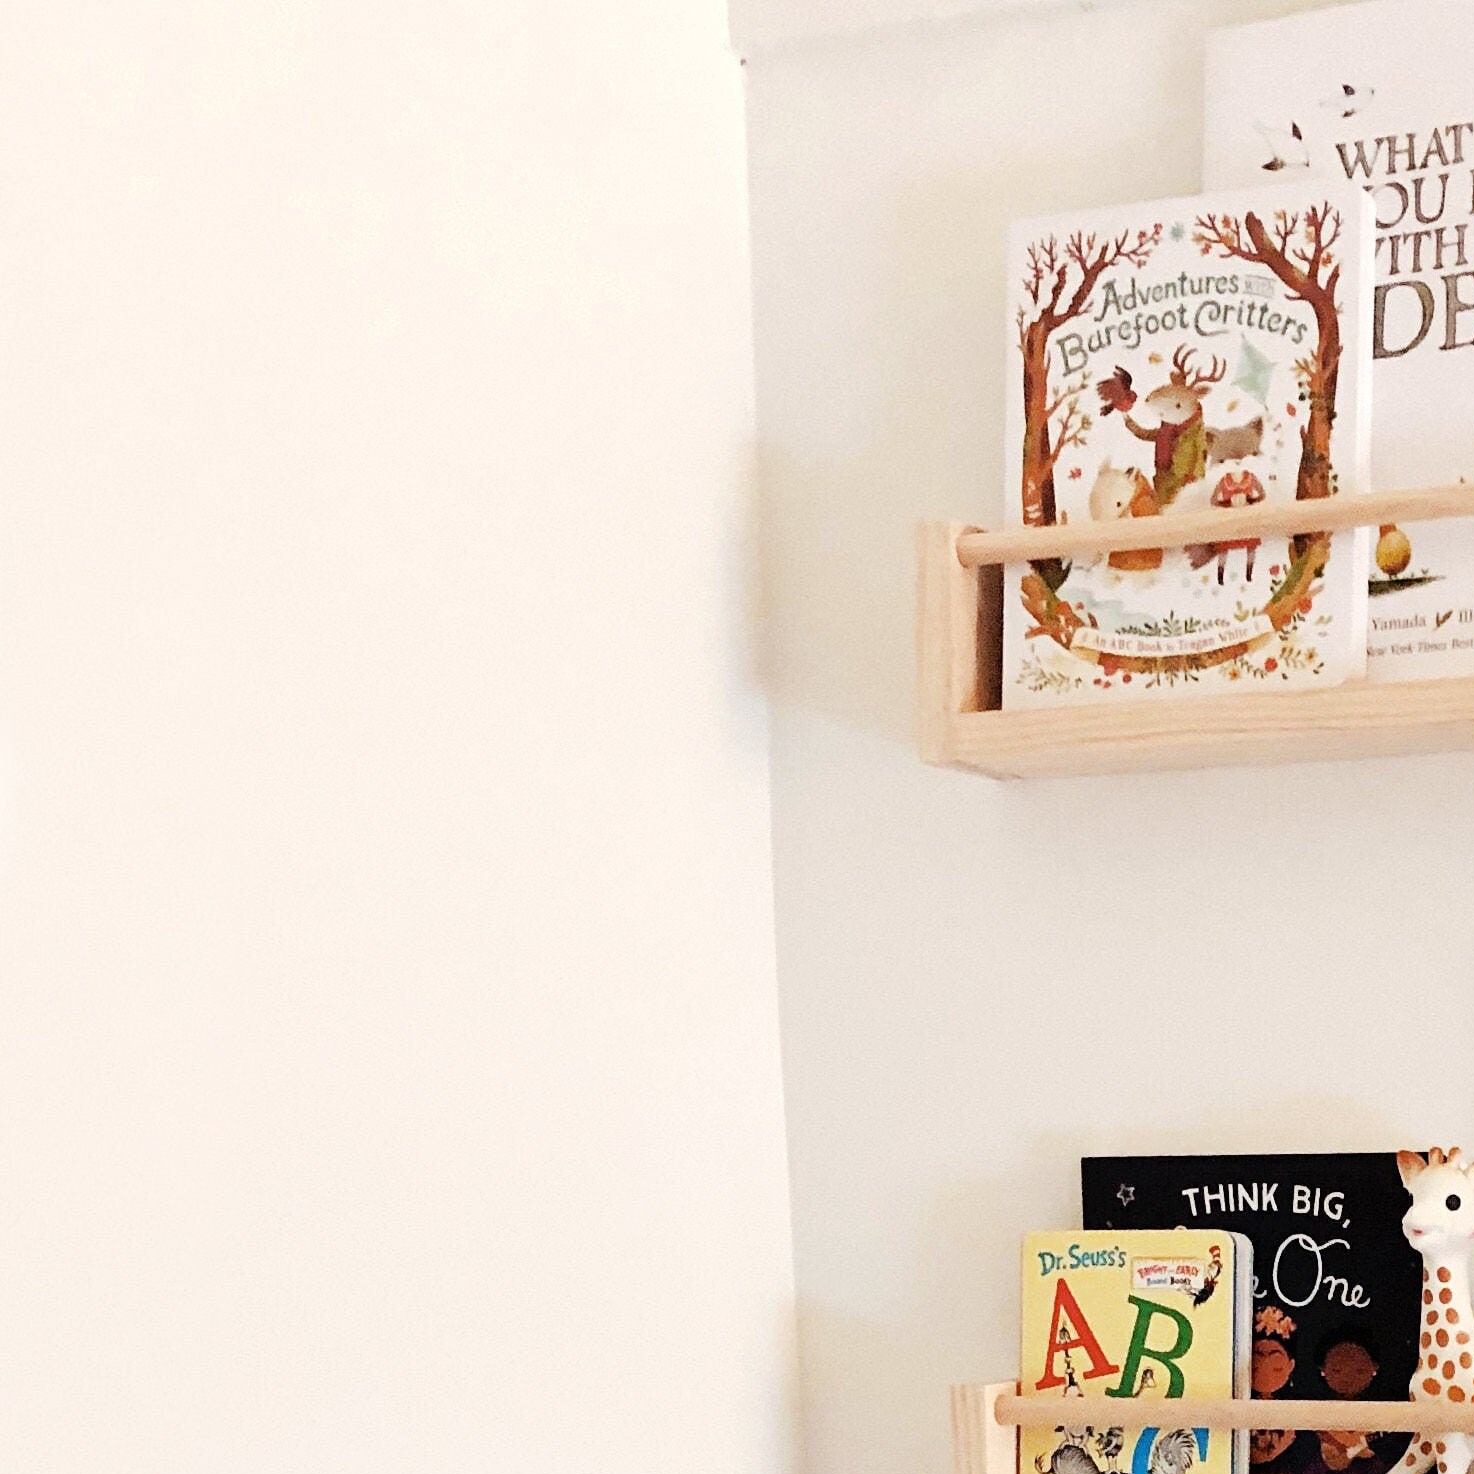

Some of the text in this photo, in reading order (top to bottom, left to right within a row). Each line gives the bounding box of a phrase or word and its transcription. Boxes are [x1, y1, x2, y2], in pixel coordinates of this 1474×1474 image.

[1335, 123, 1474, 180] WHAT
[1362, 173, 1450, 229] OU
[1375, 224, 1469, 276] ITH
[1094, 271, 1239, 322] Adventures
[1056, 300, 1309, 377] Barefoot Critters
[1371, 613, 1427, 632] Yamada
[1182, 1183, 1352, 1229] THINK BIG,
[1037, 1251, 1067, 1277] Dr.
[1273, 1233, 1371, 1308] One
[1035, 1277, 1194, 1400] A B
